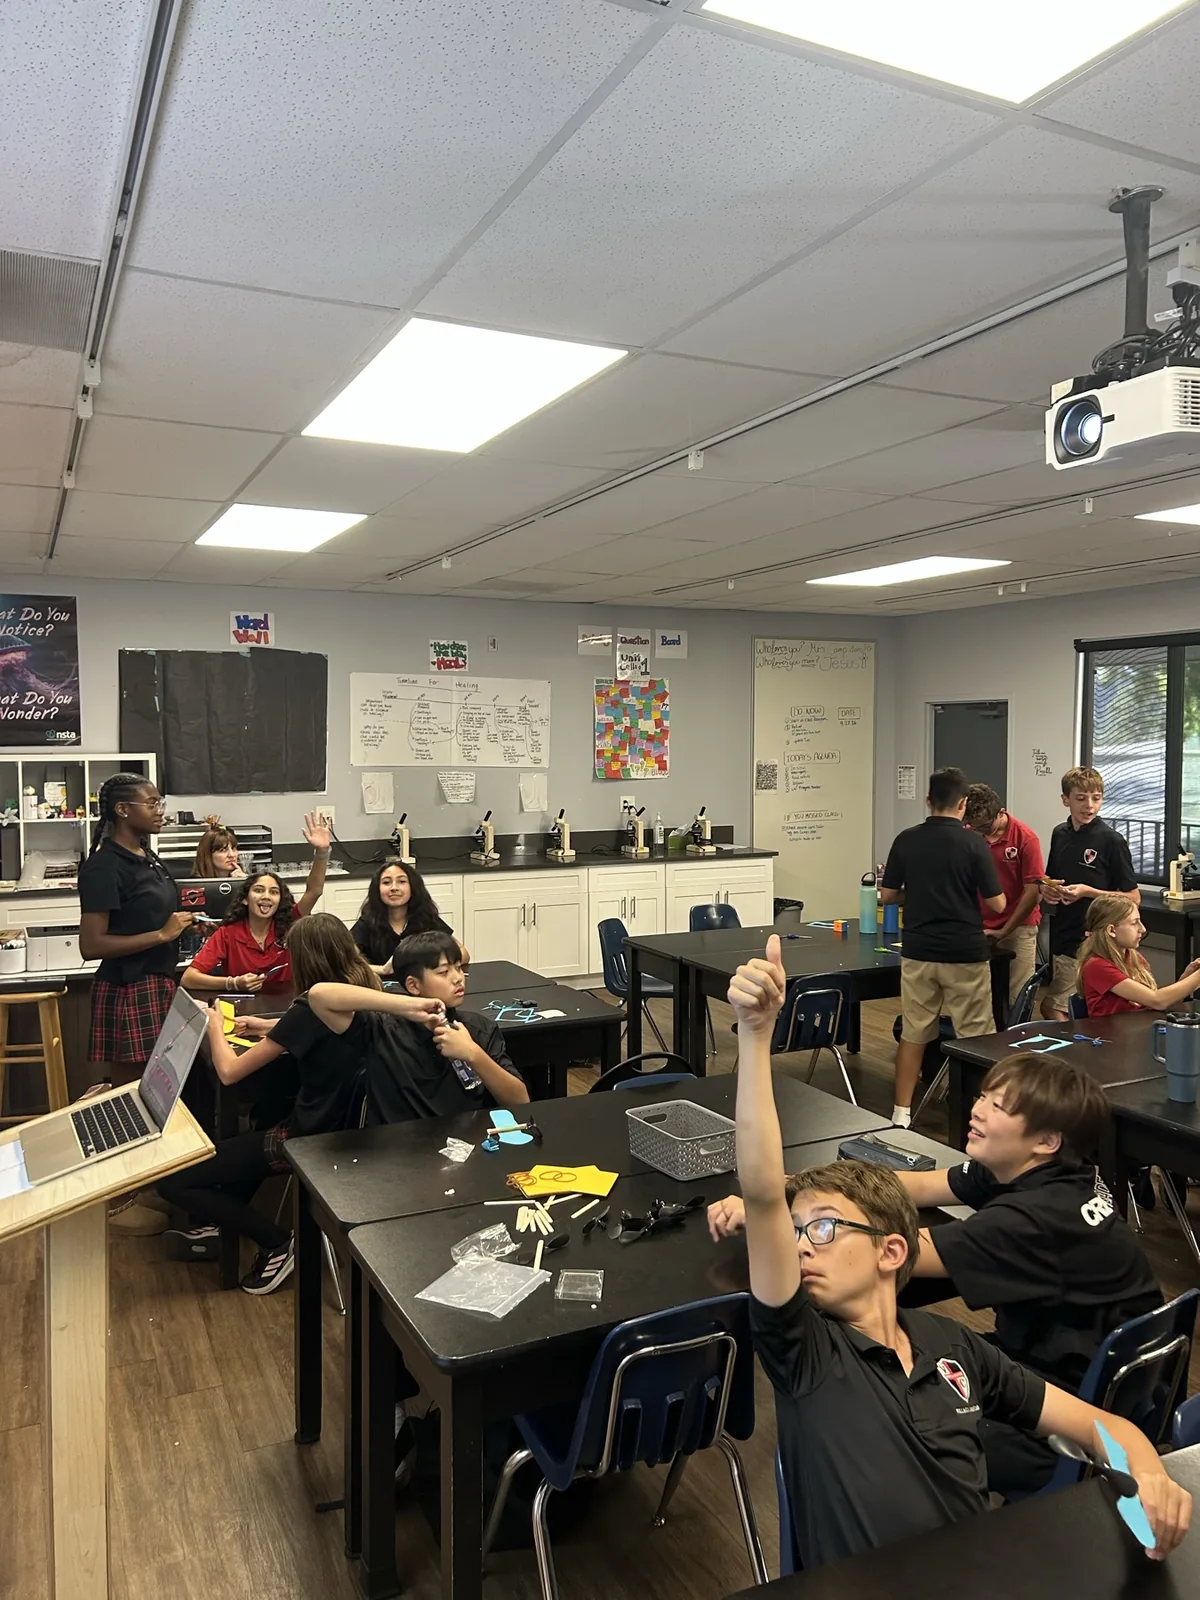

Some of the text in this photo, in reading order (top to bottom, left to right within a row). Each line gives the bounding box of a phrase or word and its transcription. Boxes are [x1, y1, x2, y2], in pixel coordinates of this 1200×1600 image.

[19, 607, 42, 620] Do
[48, 607, 70, 622] You
[235, 613, 269, 630] Word
[232, 630, 269, 644] Wall
[620, 636, 649, 645] Question
[661, 635, 681, 646] Board
[621, 653, 641, 662] Unit
[641, 658, 650, 675] 1
[22, 691, 45, 705] Do
[49, 690, 73, 705] You
[841, 709, 856, 717] DATE
[56, 731, 76, 739] nsta
